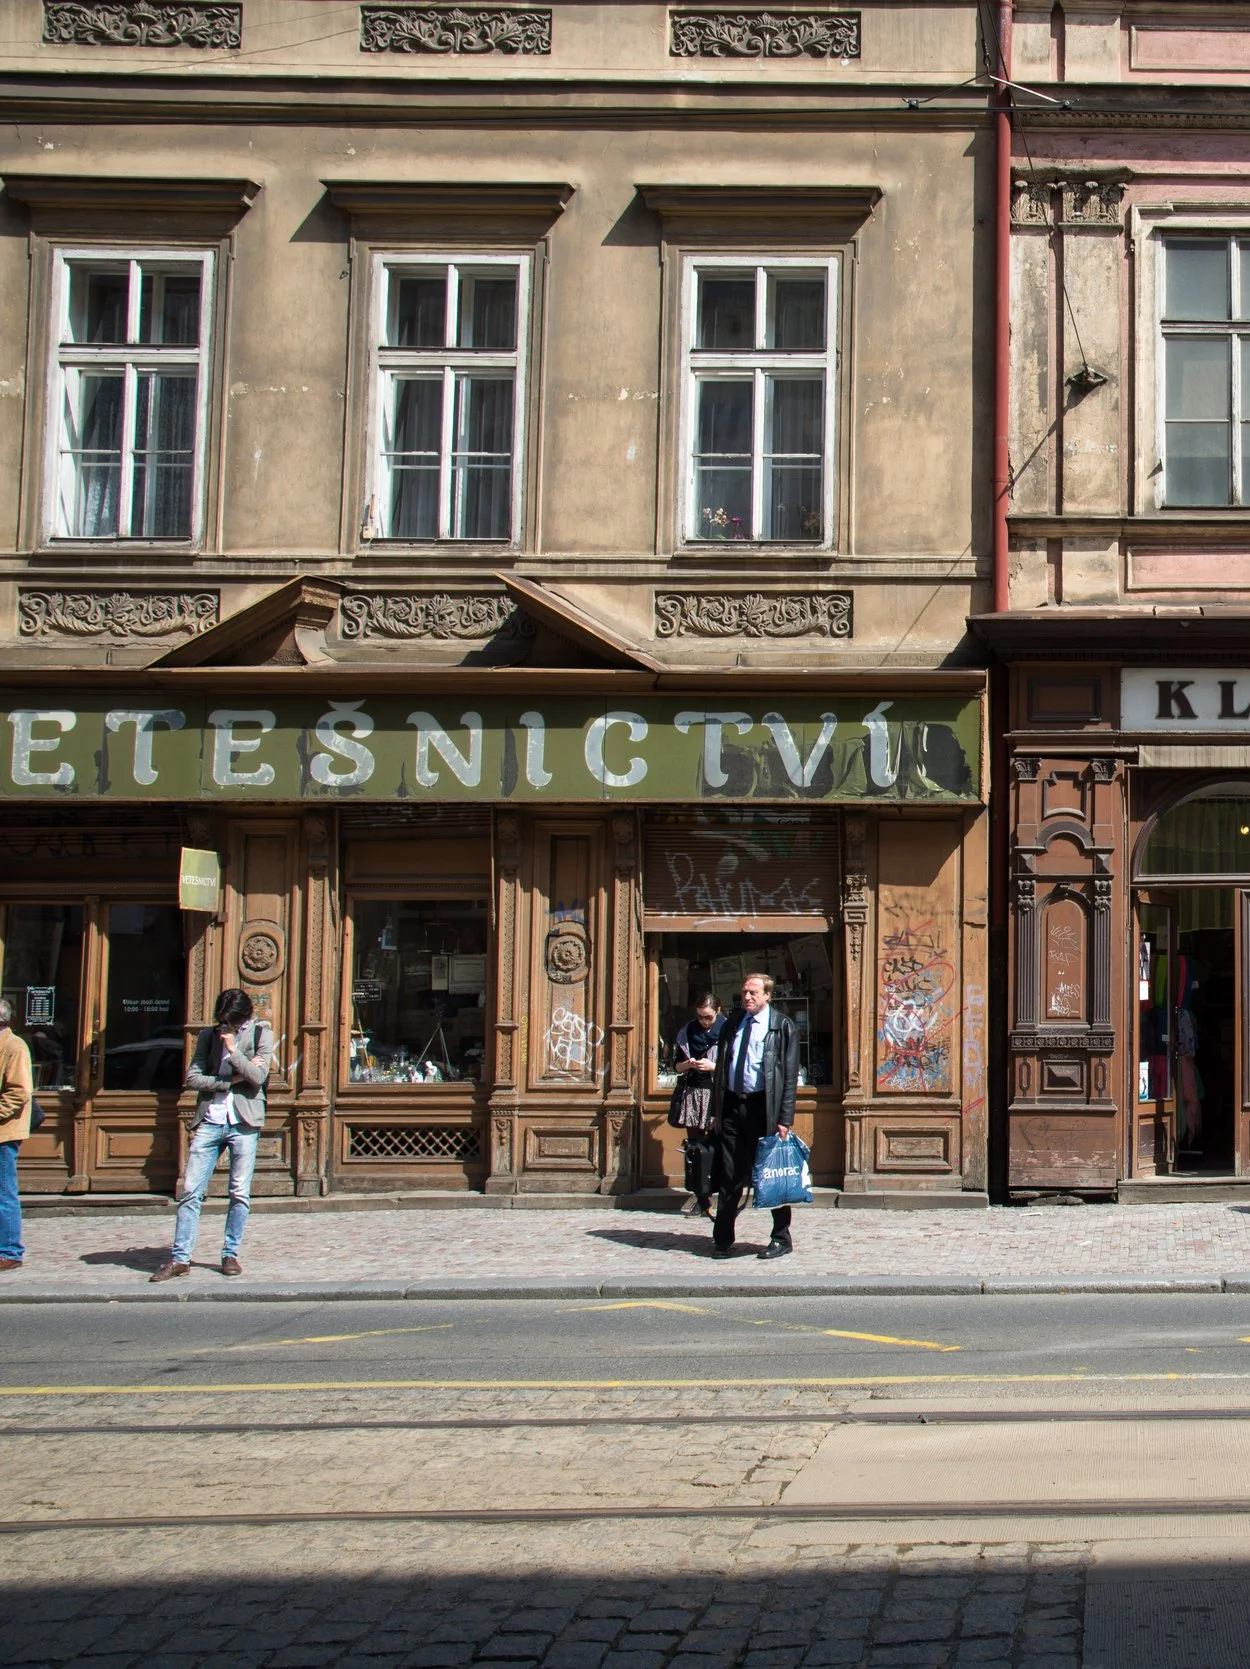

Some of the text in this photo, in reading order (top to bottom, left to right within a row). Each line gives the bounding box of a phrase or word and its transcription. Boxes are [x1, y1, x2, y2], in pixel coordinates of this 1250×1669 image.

[7, 699, 898, 787] ETEŠNICTVÍ
[182, 875, 216, 887] VETEŠNICTVÍ
[763, 1166, 800, 1179] anorac
